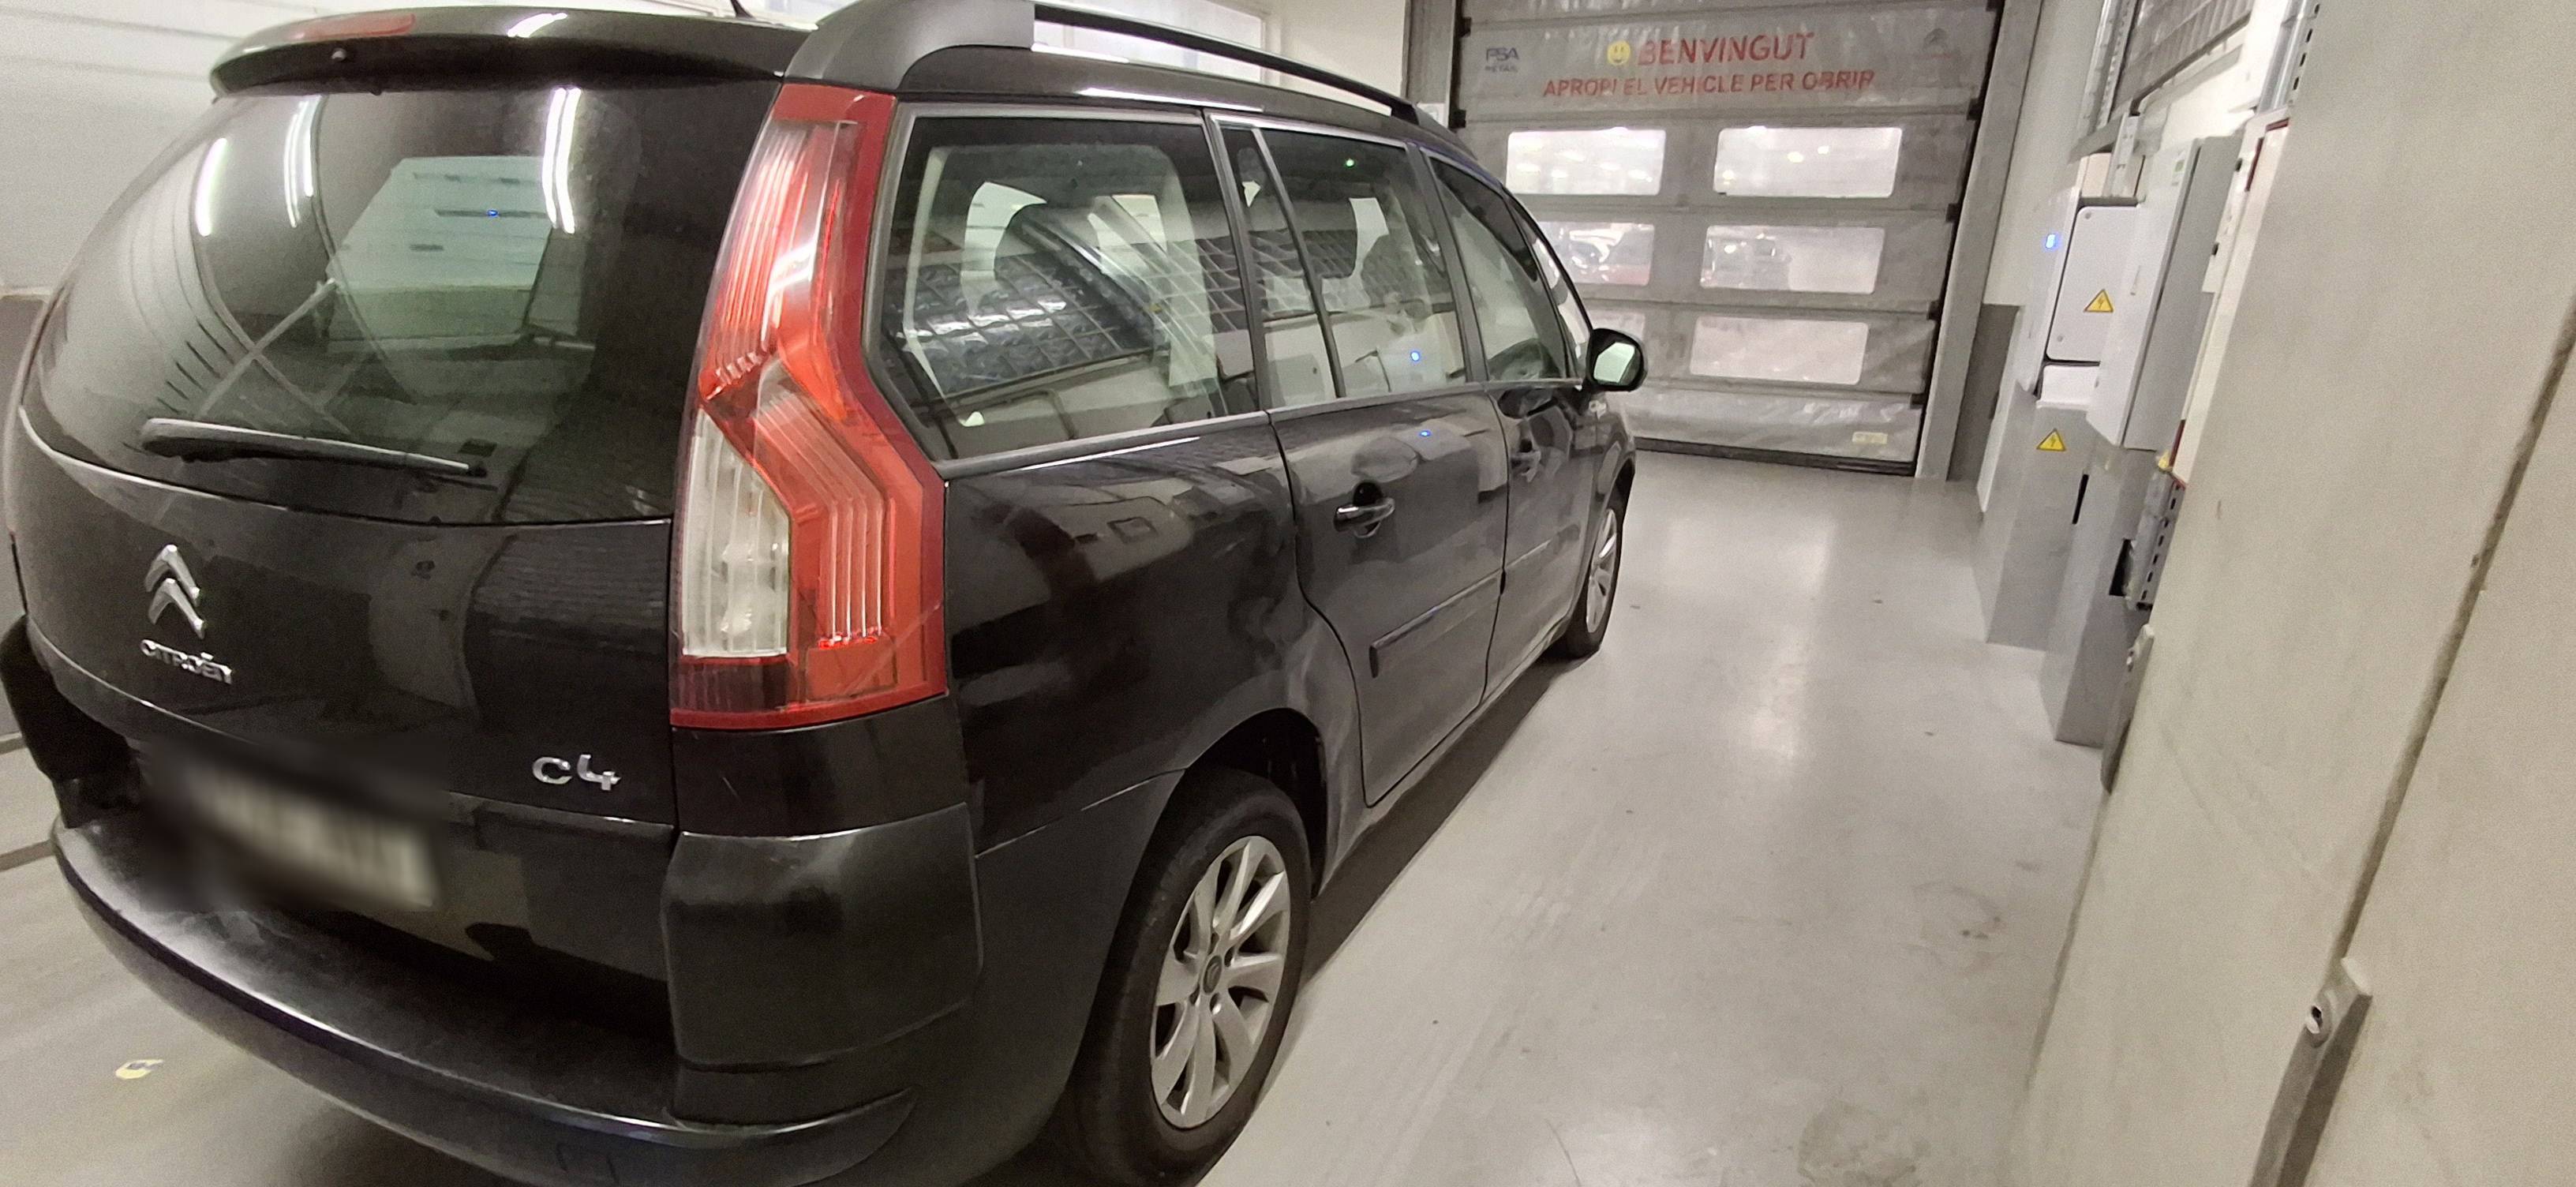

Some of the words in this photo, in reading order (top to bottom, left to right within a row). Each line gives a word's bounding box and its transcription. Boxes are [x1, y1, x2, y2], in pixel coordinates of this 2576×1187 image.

[1486, 47, 1519, 62] PSA
[1638, 32, 1815, 65] BENVINGUT
[1543, 78, 1618, 97] APROPI
[1623, 77, 1647, 95] EL
[1750, 73, 1795, 92] PER
[532, 754, 622, 791] C4
